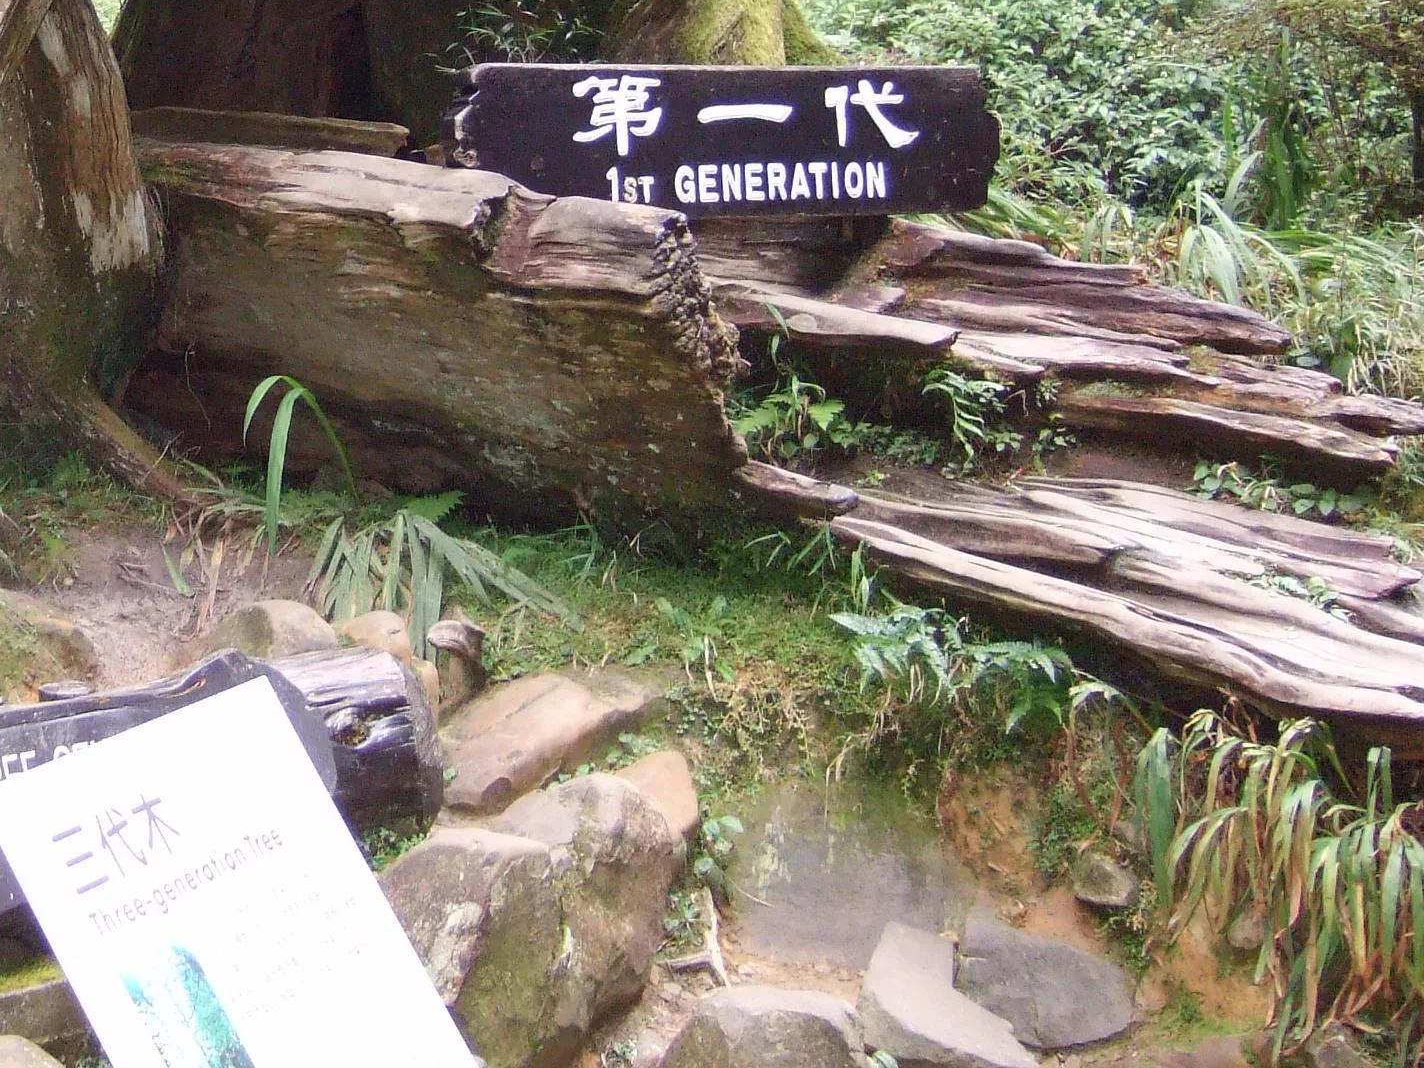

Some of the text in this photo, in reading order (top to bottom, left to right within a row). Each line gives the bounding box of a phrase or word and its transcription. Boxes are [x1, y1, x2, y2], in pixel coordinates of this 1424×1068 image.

[572, 74, 920, 156] 第一代
[605, 161, 888, 204] 1ST GENERATION
[51, 793, 181, 895] 三代木
[88, 827, 284, 937] Three-generation Tree
